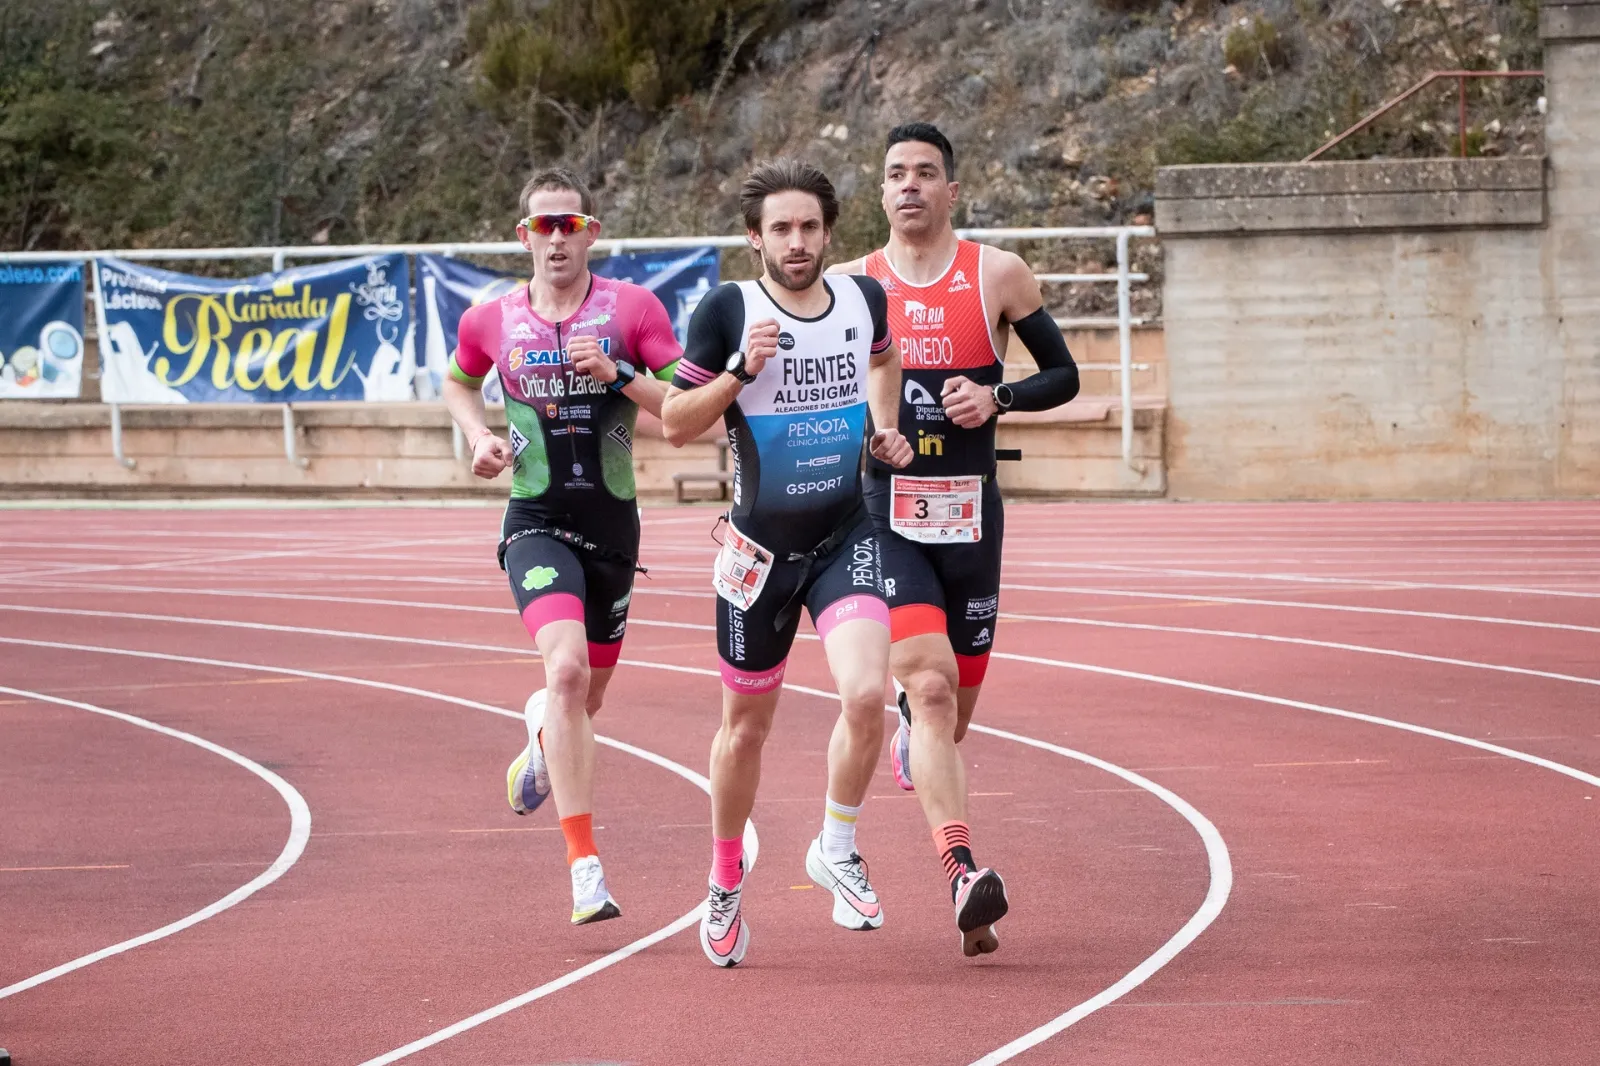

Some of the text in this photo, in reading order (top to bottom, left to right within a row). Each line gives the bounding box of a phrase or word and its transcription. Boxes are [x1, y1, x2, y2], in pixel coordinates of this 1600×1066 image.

[226, 284, 328, 323] Cañada
[154, 292, 357, 391] Real
[900, 336, 953, 365] PINEDO
[783, 351, 856, 386] FUENTES
[519, 370, 607, 398] Ortiz de Zarate
[773, 381, 859, 404] ALUSIGMA
[774, 404, 819, 413] ALEACIONES
[830, 397, 858, 409] ALUMINIO
[916, 406, 946, 414] Diputaci
[788, 417, 850, 437] PEÑOTA
[926, 413, 945, 421] Soria
[820, 434, 850, 444] DENTAL
[786, 475, 843, 495] GSPORT
[915, 499, 929, 519] 3
[846, 537, 874, 587] PEÑOTA
[836, 601, 858, 619] psi
[733, 606, 746, 661] USIGMA
